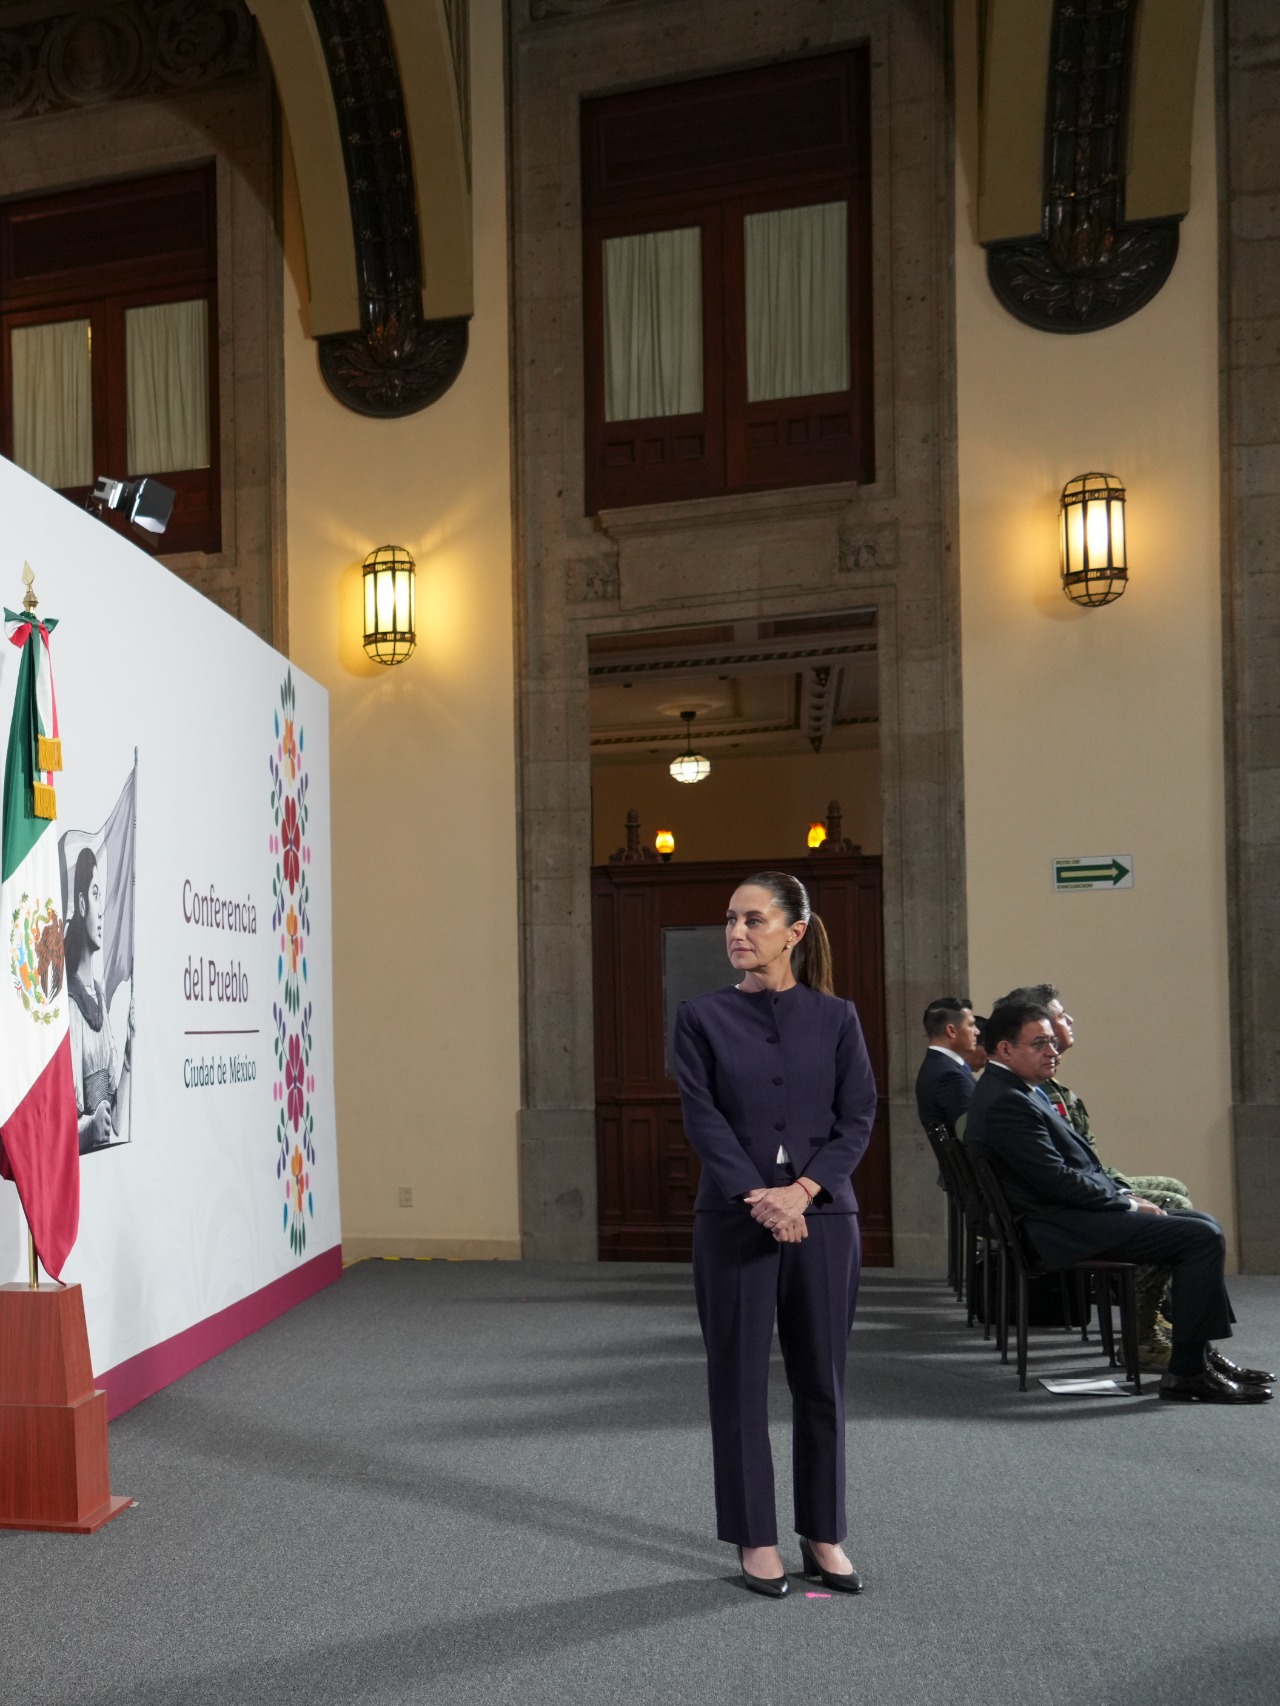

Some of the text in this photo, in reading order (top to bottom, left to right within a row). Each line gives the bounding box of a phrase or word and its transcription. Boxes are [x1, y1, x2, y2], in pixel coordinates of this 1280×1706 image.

[182, 879, 257, 935] Conferencia
[184, 955, 249, 1003] del Pueblo
[184, 1054, 257, 1089] Ciudad de México
